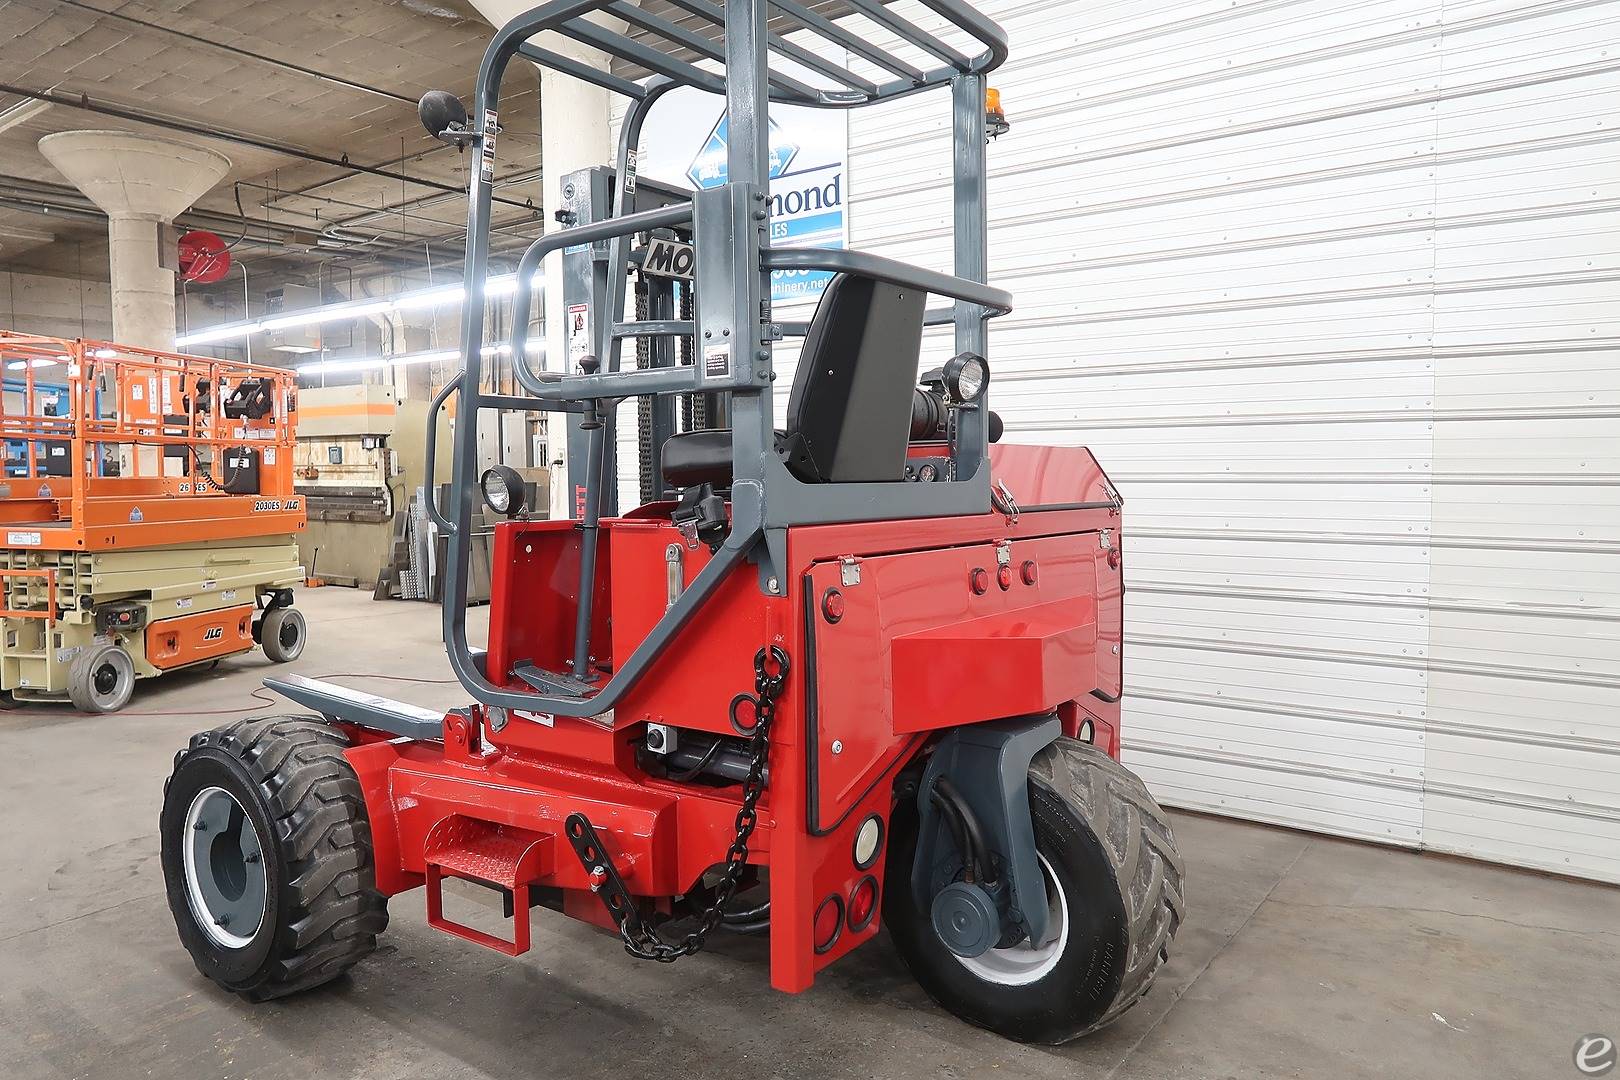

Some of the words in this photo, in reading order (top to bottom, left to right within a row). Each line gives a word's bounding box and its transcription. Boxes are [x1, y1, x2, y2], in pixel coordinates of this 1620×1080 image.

[255, 501, 280, 511] 2030ES
[285, 500, 299, 510] JLG
[203, 627, 223, 640] JLG
